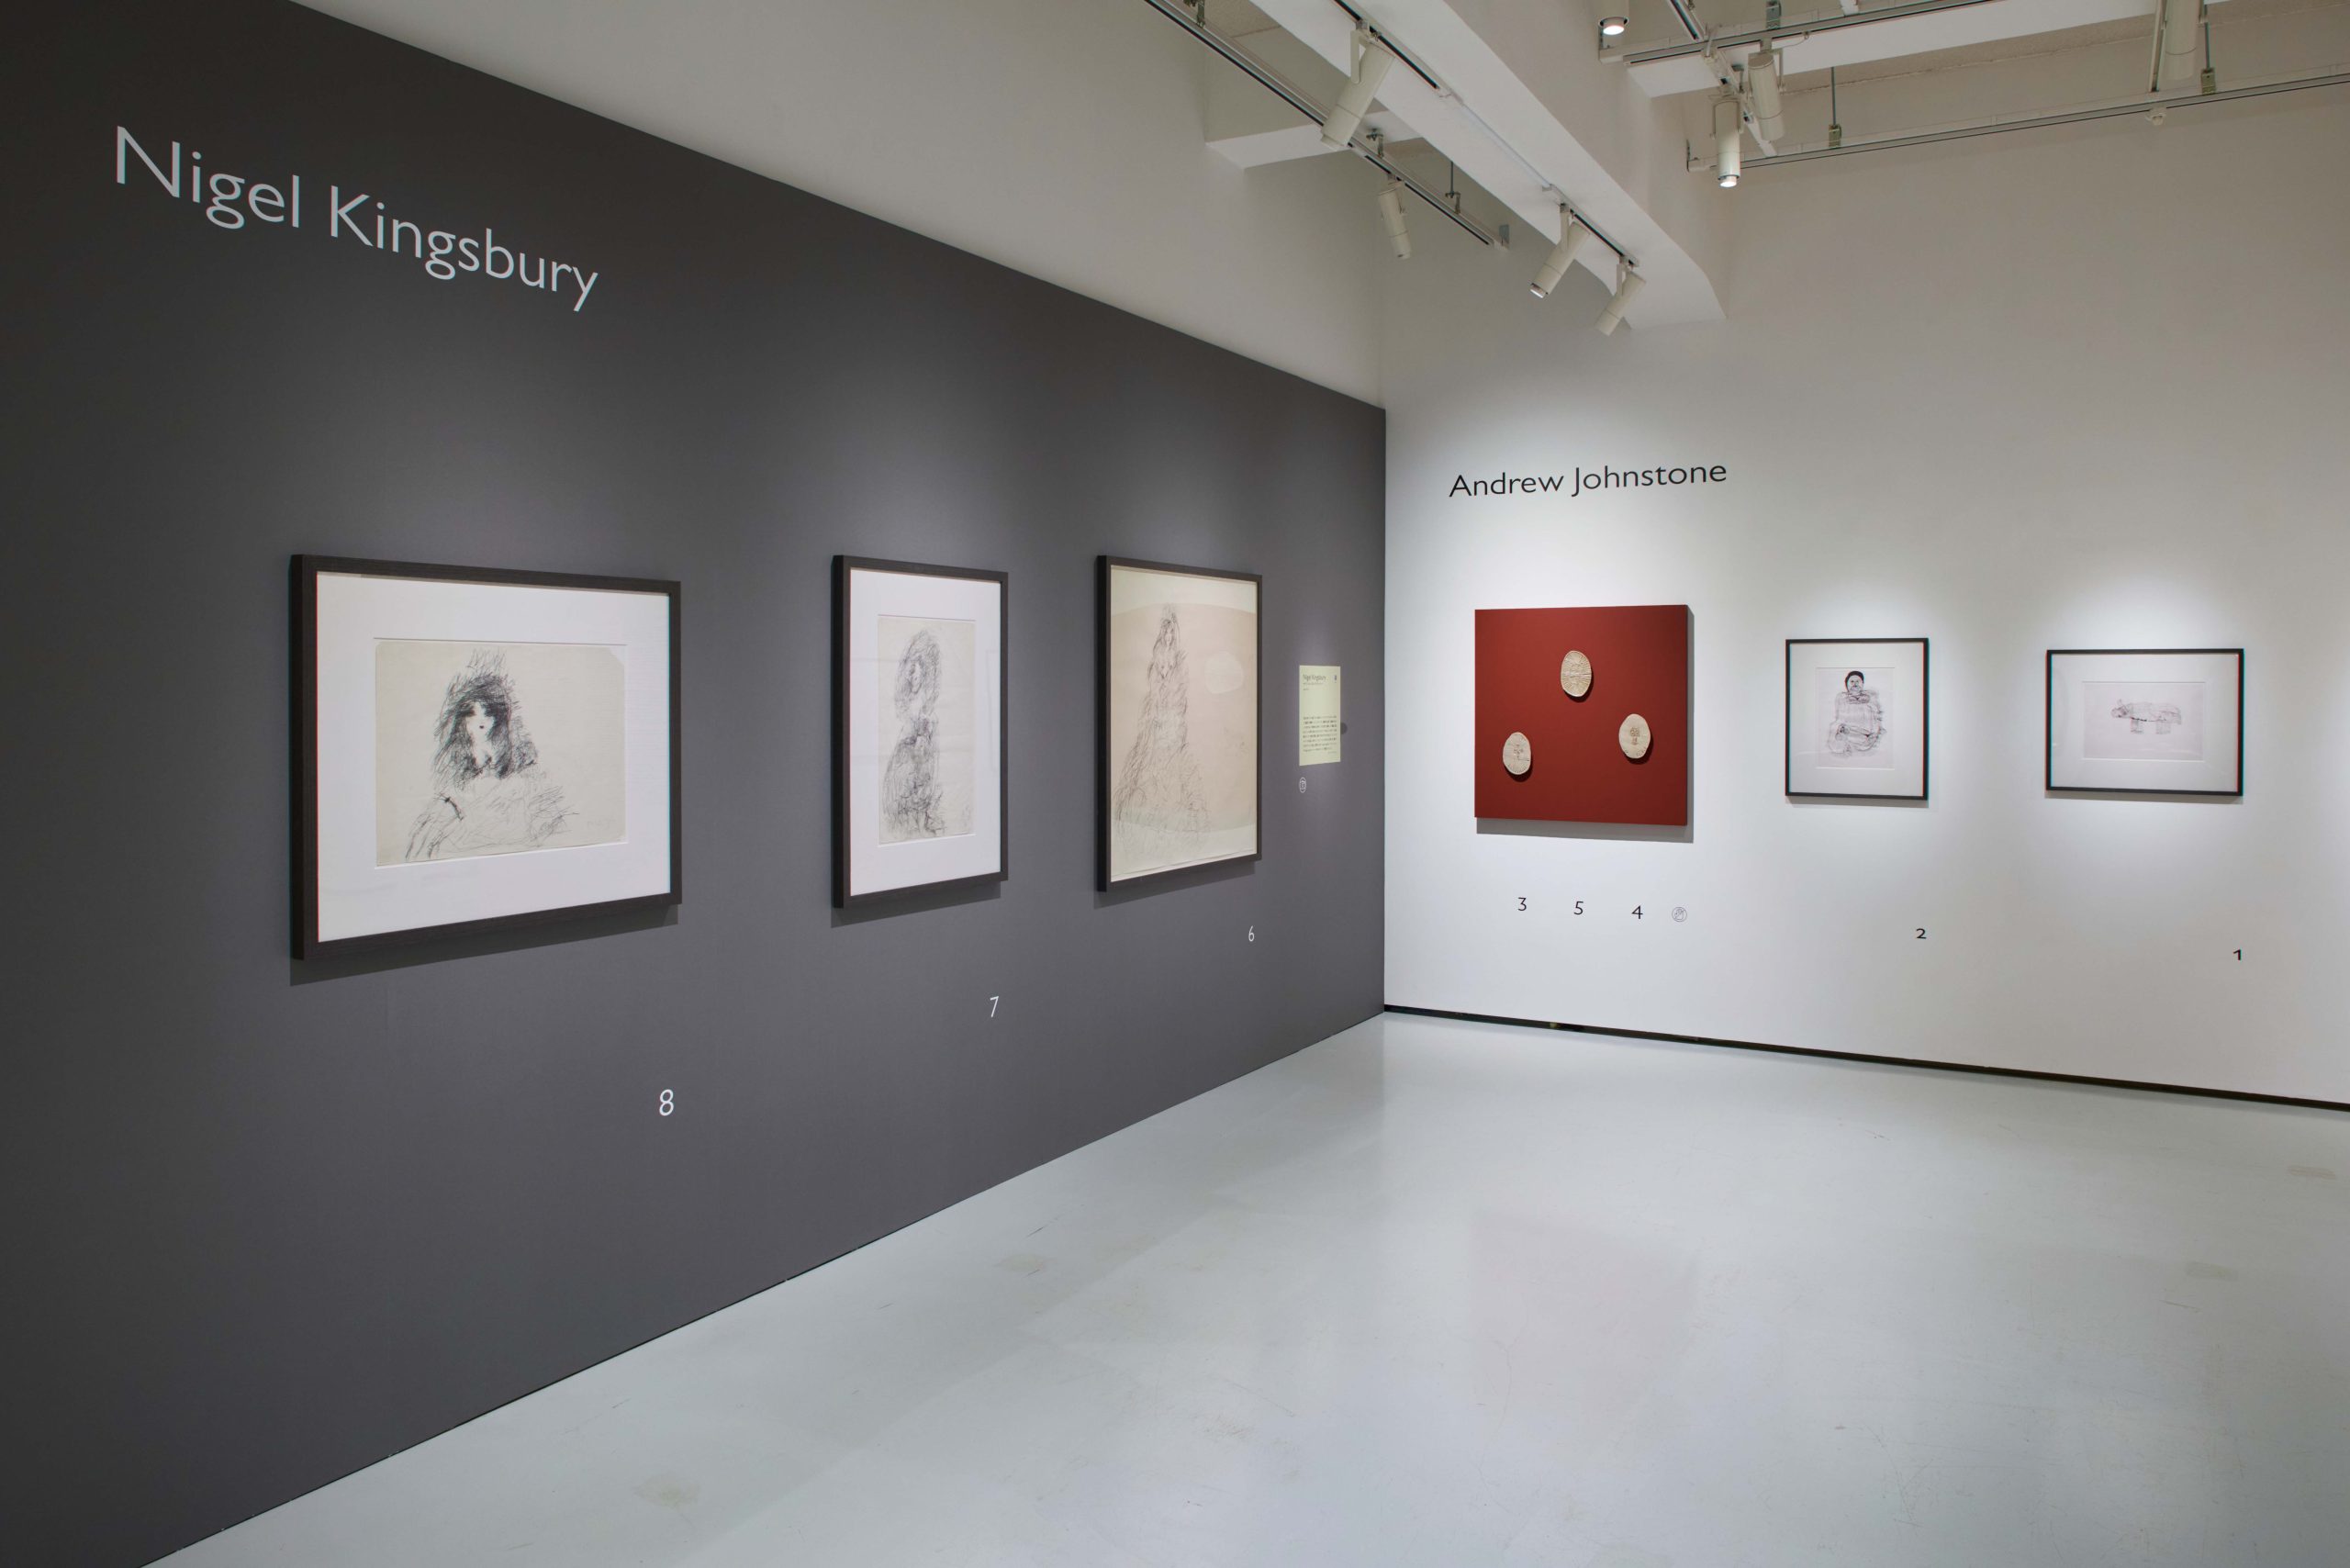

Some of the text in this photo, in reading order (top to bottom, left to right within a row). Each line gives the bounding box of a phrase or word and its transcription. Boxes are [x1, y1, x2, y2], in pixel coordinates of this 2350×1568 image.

[117, 126, 599, 312] Nigel Kingsbury
[1449, 465, 1727, 498] Andrew Johnstone
[1517, 897, 1644, 920] 3 5 4
[1248, 925, 1256, 942] 6
[1916, 927, 1927, 940] 2
[2233, 948, 2242, 961] 1
[990, 995, 1000, 1018] 7
[658, 1089, 675, 1116] 8
